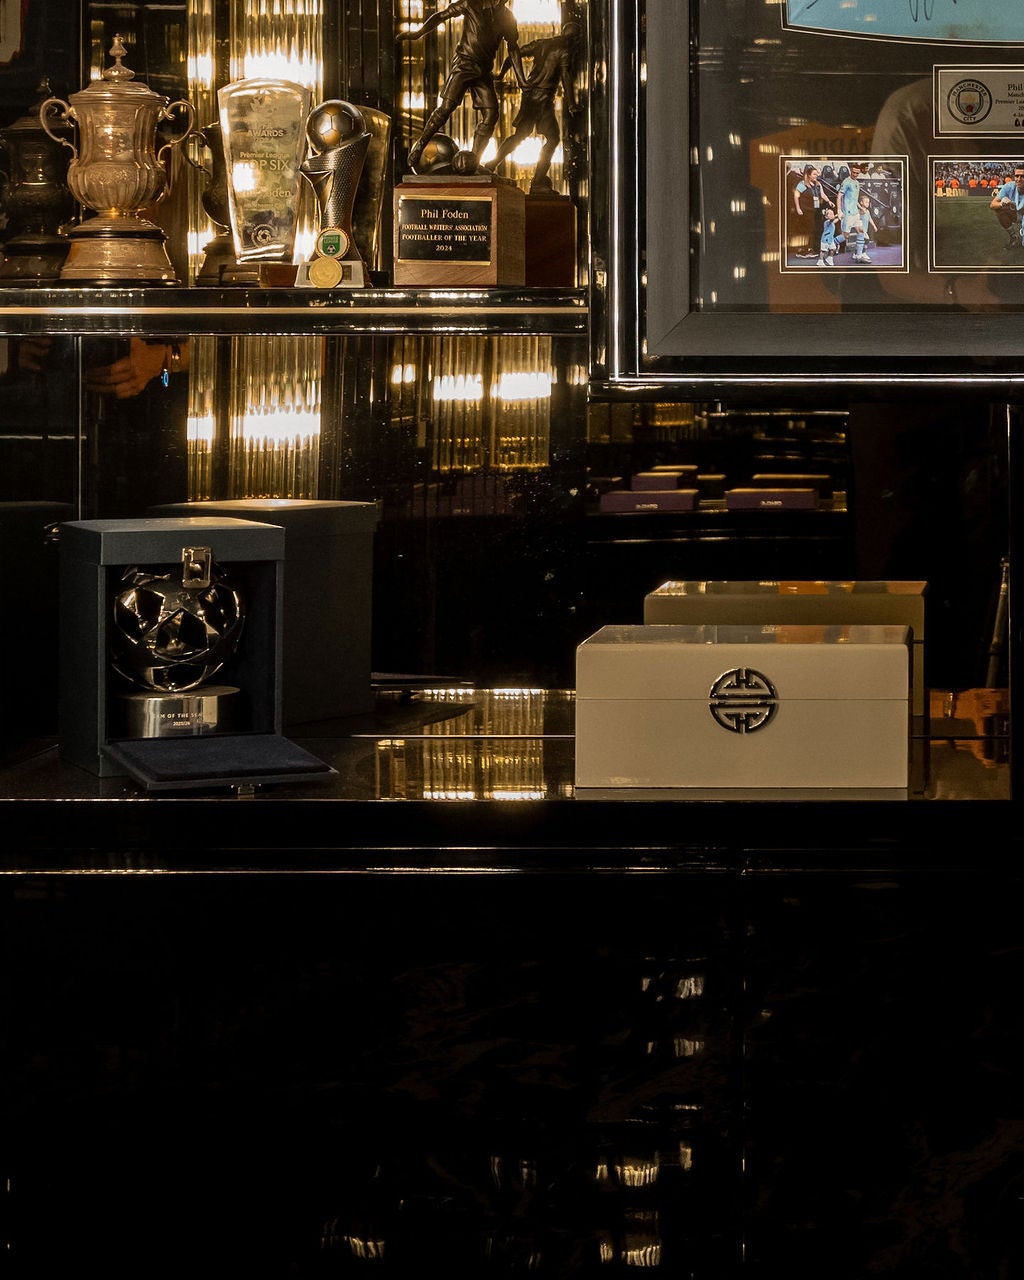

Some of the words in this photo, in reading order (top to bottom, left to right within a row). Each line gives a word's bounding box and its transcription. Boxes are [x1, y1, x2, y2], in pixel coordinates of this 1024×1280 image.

[951, 83, 987, 97] MANCHESTER
[1007, 83, 1023, 91] Phil
[247, 129, 284, 137] AWARDS
[269, 160, 289, 171] SIX
[421, 209, 439, 219] Phil
[442, 209, 469, 219] Foden
[401, 223, 428, 231] FOOTBALL
[455, 224, 488, 232] ASSOCIATION
